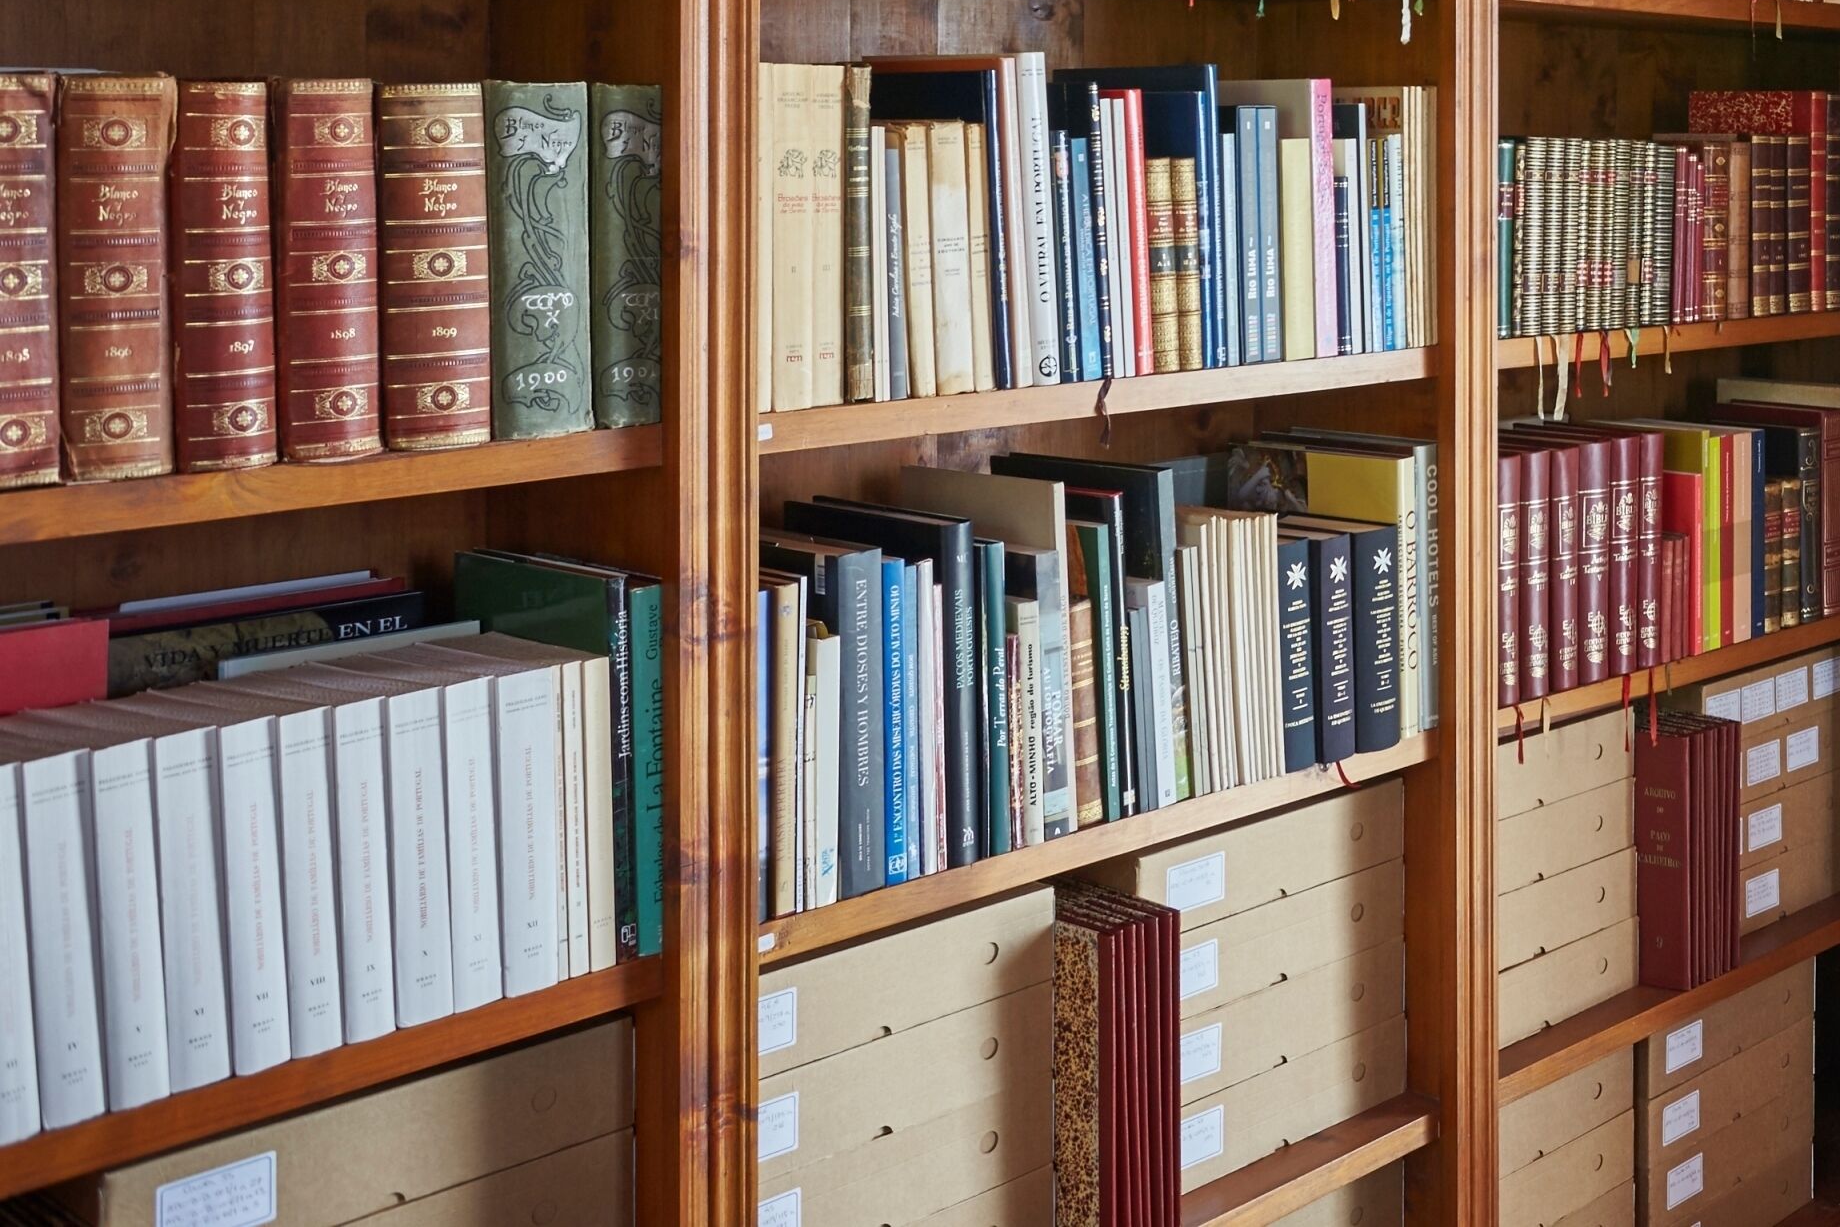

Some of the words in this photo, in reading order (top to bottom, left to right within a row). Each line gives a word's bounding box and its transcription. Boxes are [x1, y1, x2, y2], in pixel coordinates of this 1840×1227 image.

[1031, 116, 1043, 193] PORTUGAL
[97, 184, 139, 201] Blanco
[218, 184, 258, 201] Blanco
[322, 178, 359, 195] Blanco
[418, 178, 458, 195] Blanco
[98, 204, 138, 223] Negro
[221, 204, 258, 224] Negro
[324, 197, 359, 216] Negro
[423, 197, 458, 216] Negro
[1035, 201, 1046, 225] EM
[1037, 235, 1049, 287] VITRAL
[1247, 249, 1257, 277] LIMA
[1265, 248, 1276, 275] LIMA
[1039, 290, 1050, 303] O
[1247, 279, 1257, 300] RIO
[1265, 278, 1276, 298] RIO
[329, 326, 356, 342] 1898
[430, 325, 458, 339] 1899
[228, 339, 255, 354] 1897
[515, 369, 567, 391] 1900
[1426, 464, 1438, 520] COOL
[1405, 510, 1417, 530] O
[1427, 528, 1439, 608] HOTELS
[855, 579, 867, 631] ENTRE
[890, 585, 900, 622] MINHO
[1406, 540, 1418, 670] BARROCO
[954, 589, 964, 651] MEDIEVAIS
[144, 646, 200, 670] VIDA
[206, 642, 221, 657] Y
[230, 627, 331, 653] MUERTE
[338, 619, 372, 639] EN
[378, 615, 408, 631] EL
[612, 608, 629, 670] História
[890, 624, 900, 651] ALTO
[965, 606, 974, 686] PORTUGUESES
[1169, 619, 1181, 677] RIBATEJO
[1431, 635, 1437, 646] OF
[856, 634, 868, 692] DIOSES
[891, 652, 900, 668] DO
[955, 653, 966, 689] PAÇOS
[619, 673, 630, 703] com
[857, 694, 868, 707] Y
[889, 670, 901, 749] MISERICÓRDIAS
[1051, 690, 1063, 747] POMAR
[616, 707, 632, 758] Jardins
[857, 710, 869, 787] HOMBRES
[892, 750, 902, 770] DAS
[892, 772, 903, 830] ENCONTRO
[1643, 787, 1677, 800] ARQUIVO
